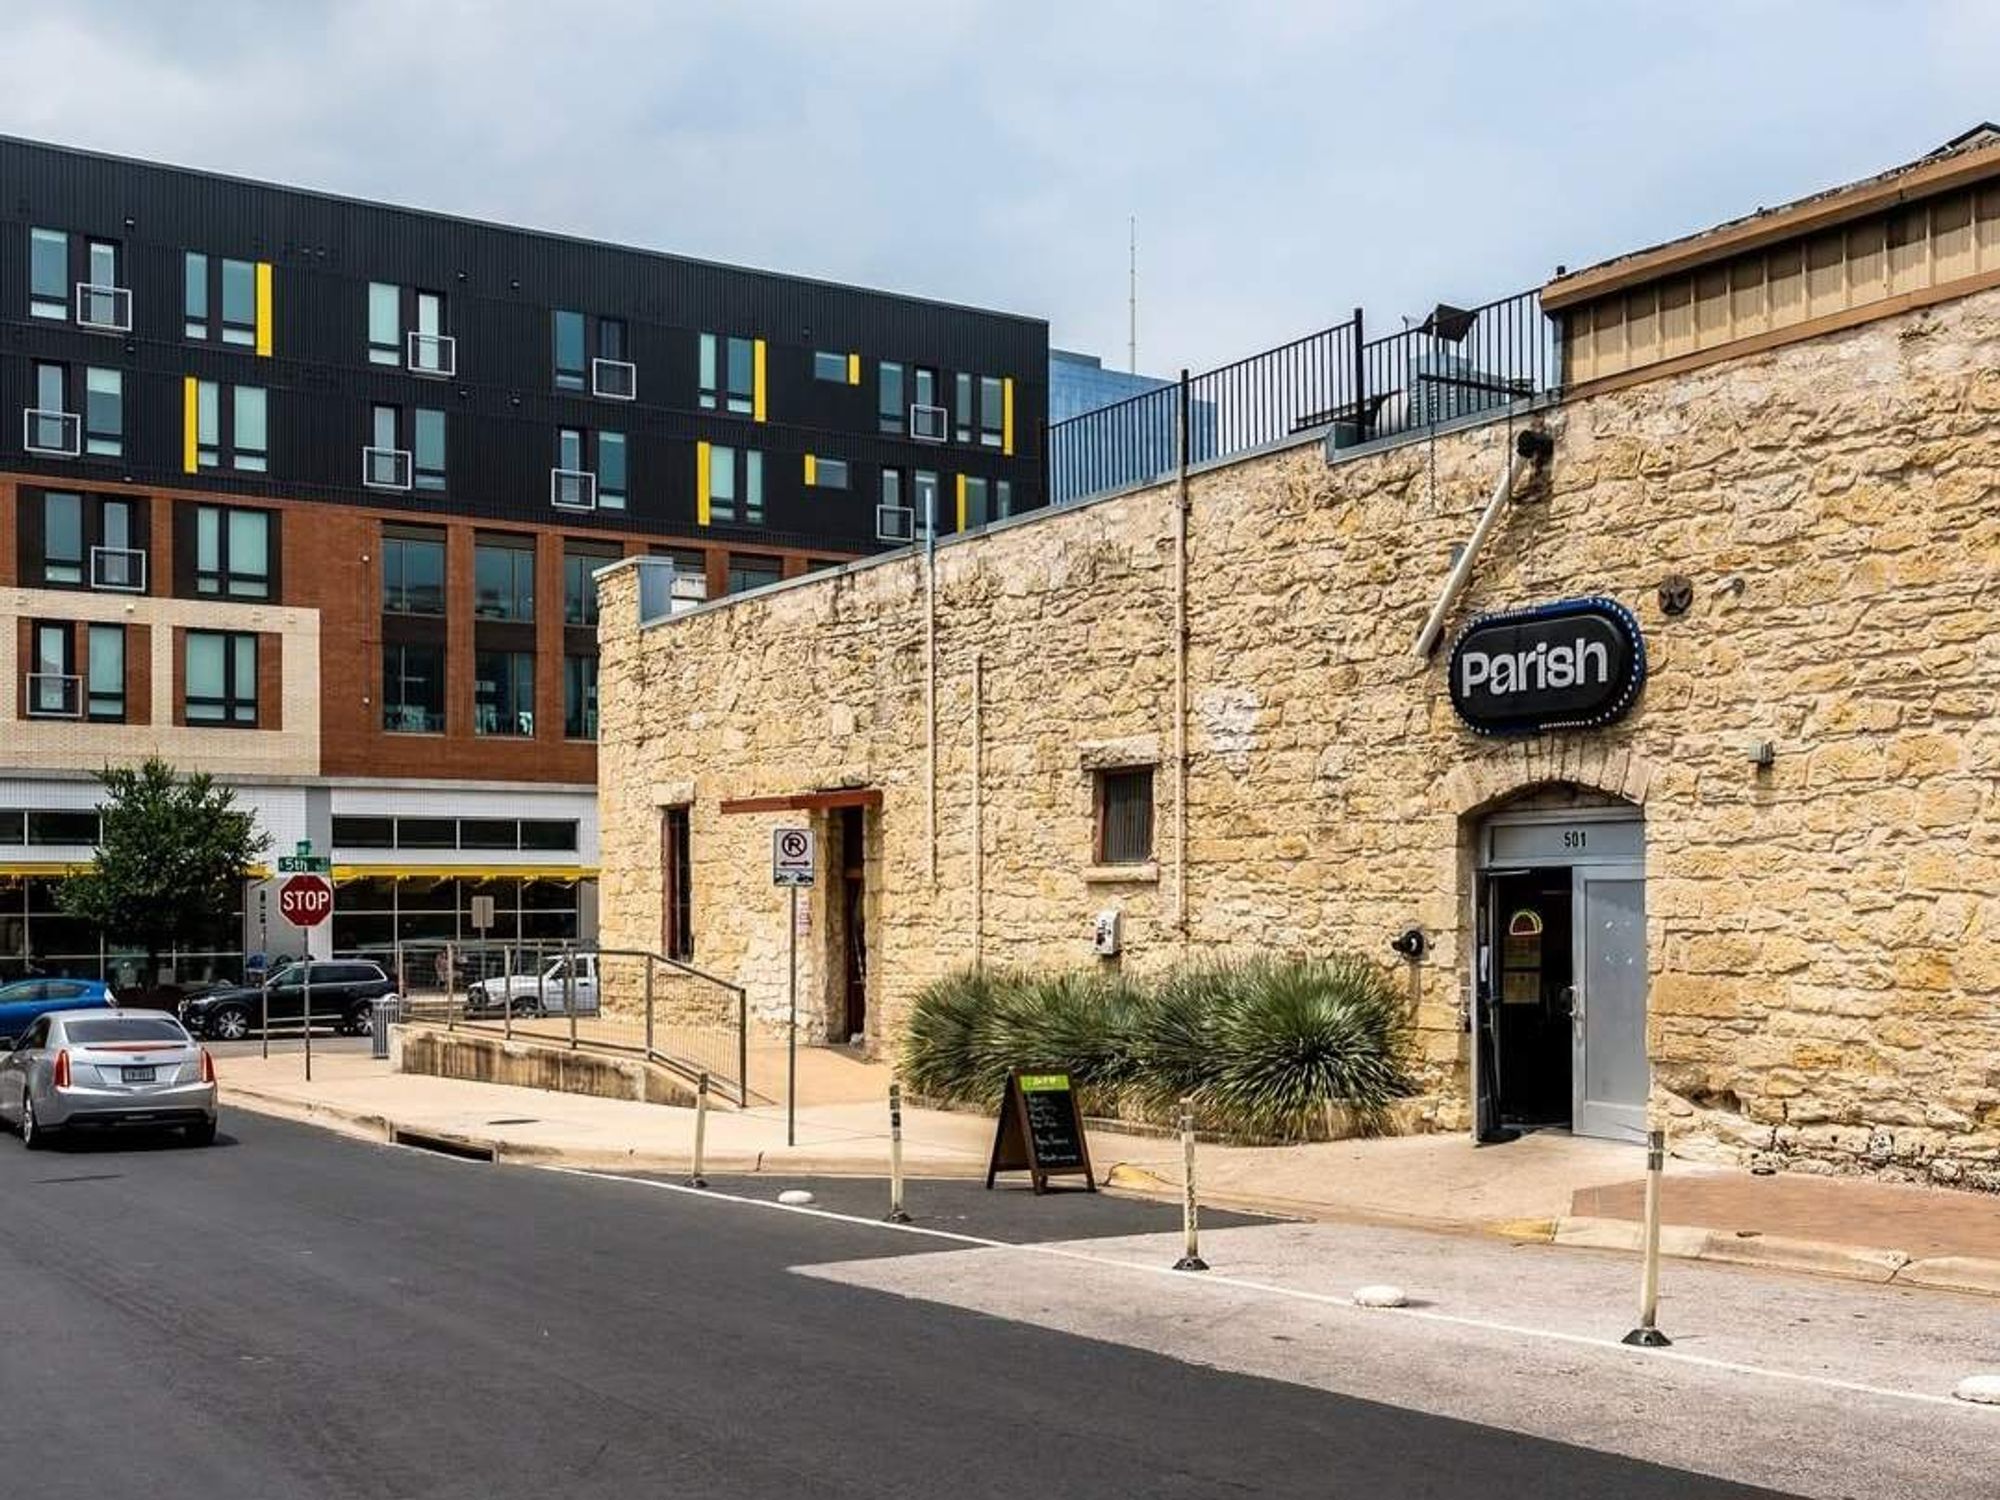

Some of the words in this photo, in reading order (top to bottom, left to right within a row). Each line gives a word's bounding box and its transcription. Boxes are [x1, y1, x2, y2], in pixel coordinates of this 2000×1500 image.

[1462, 638, 1608, 698] Parish
[1564, 831, 1586, 847] 501
[285, 858, 307, 871] 5th
[283, 891, 329, 911] STOP
